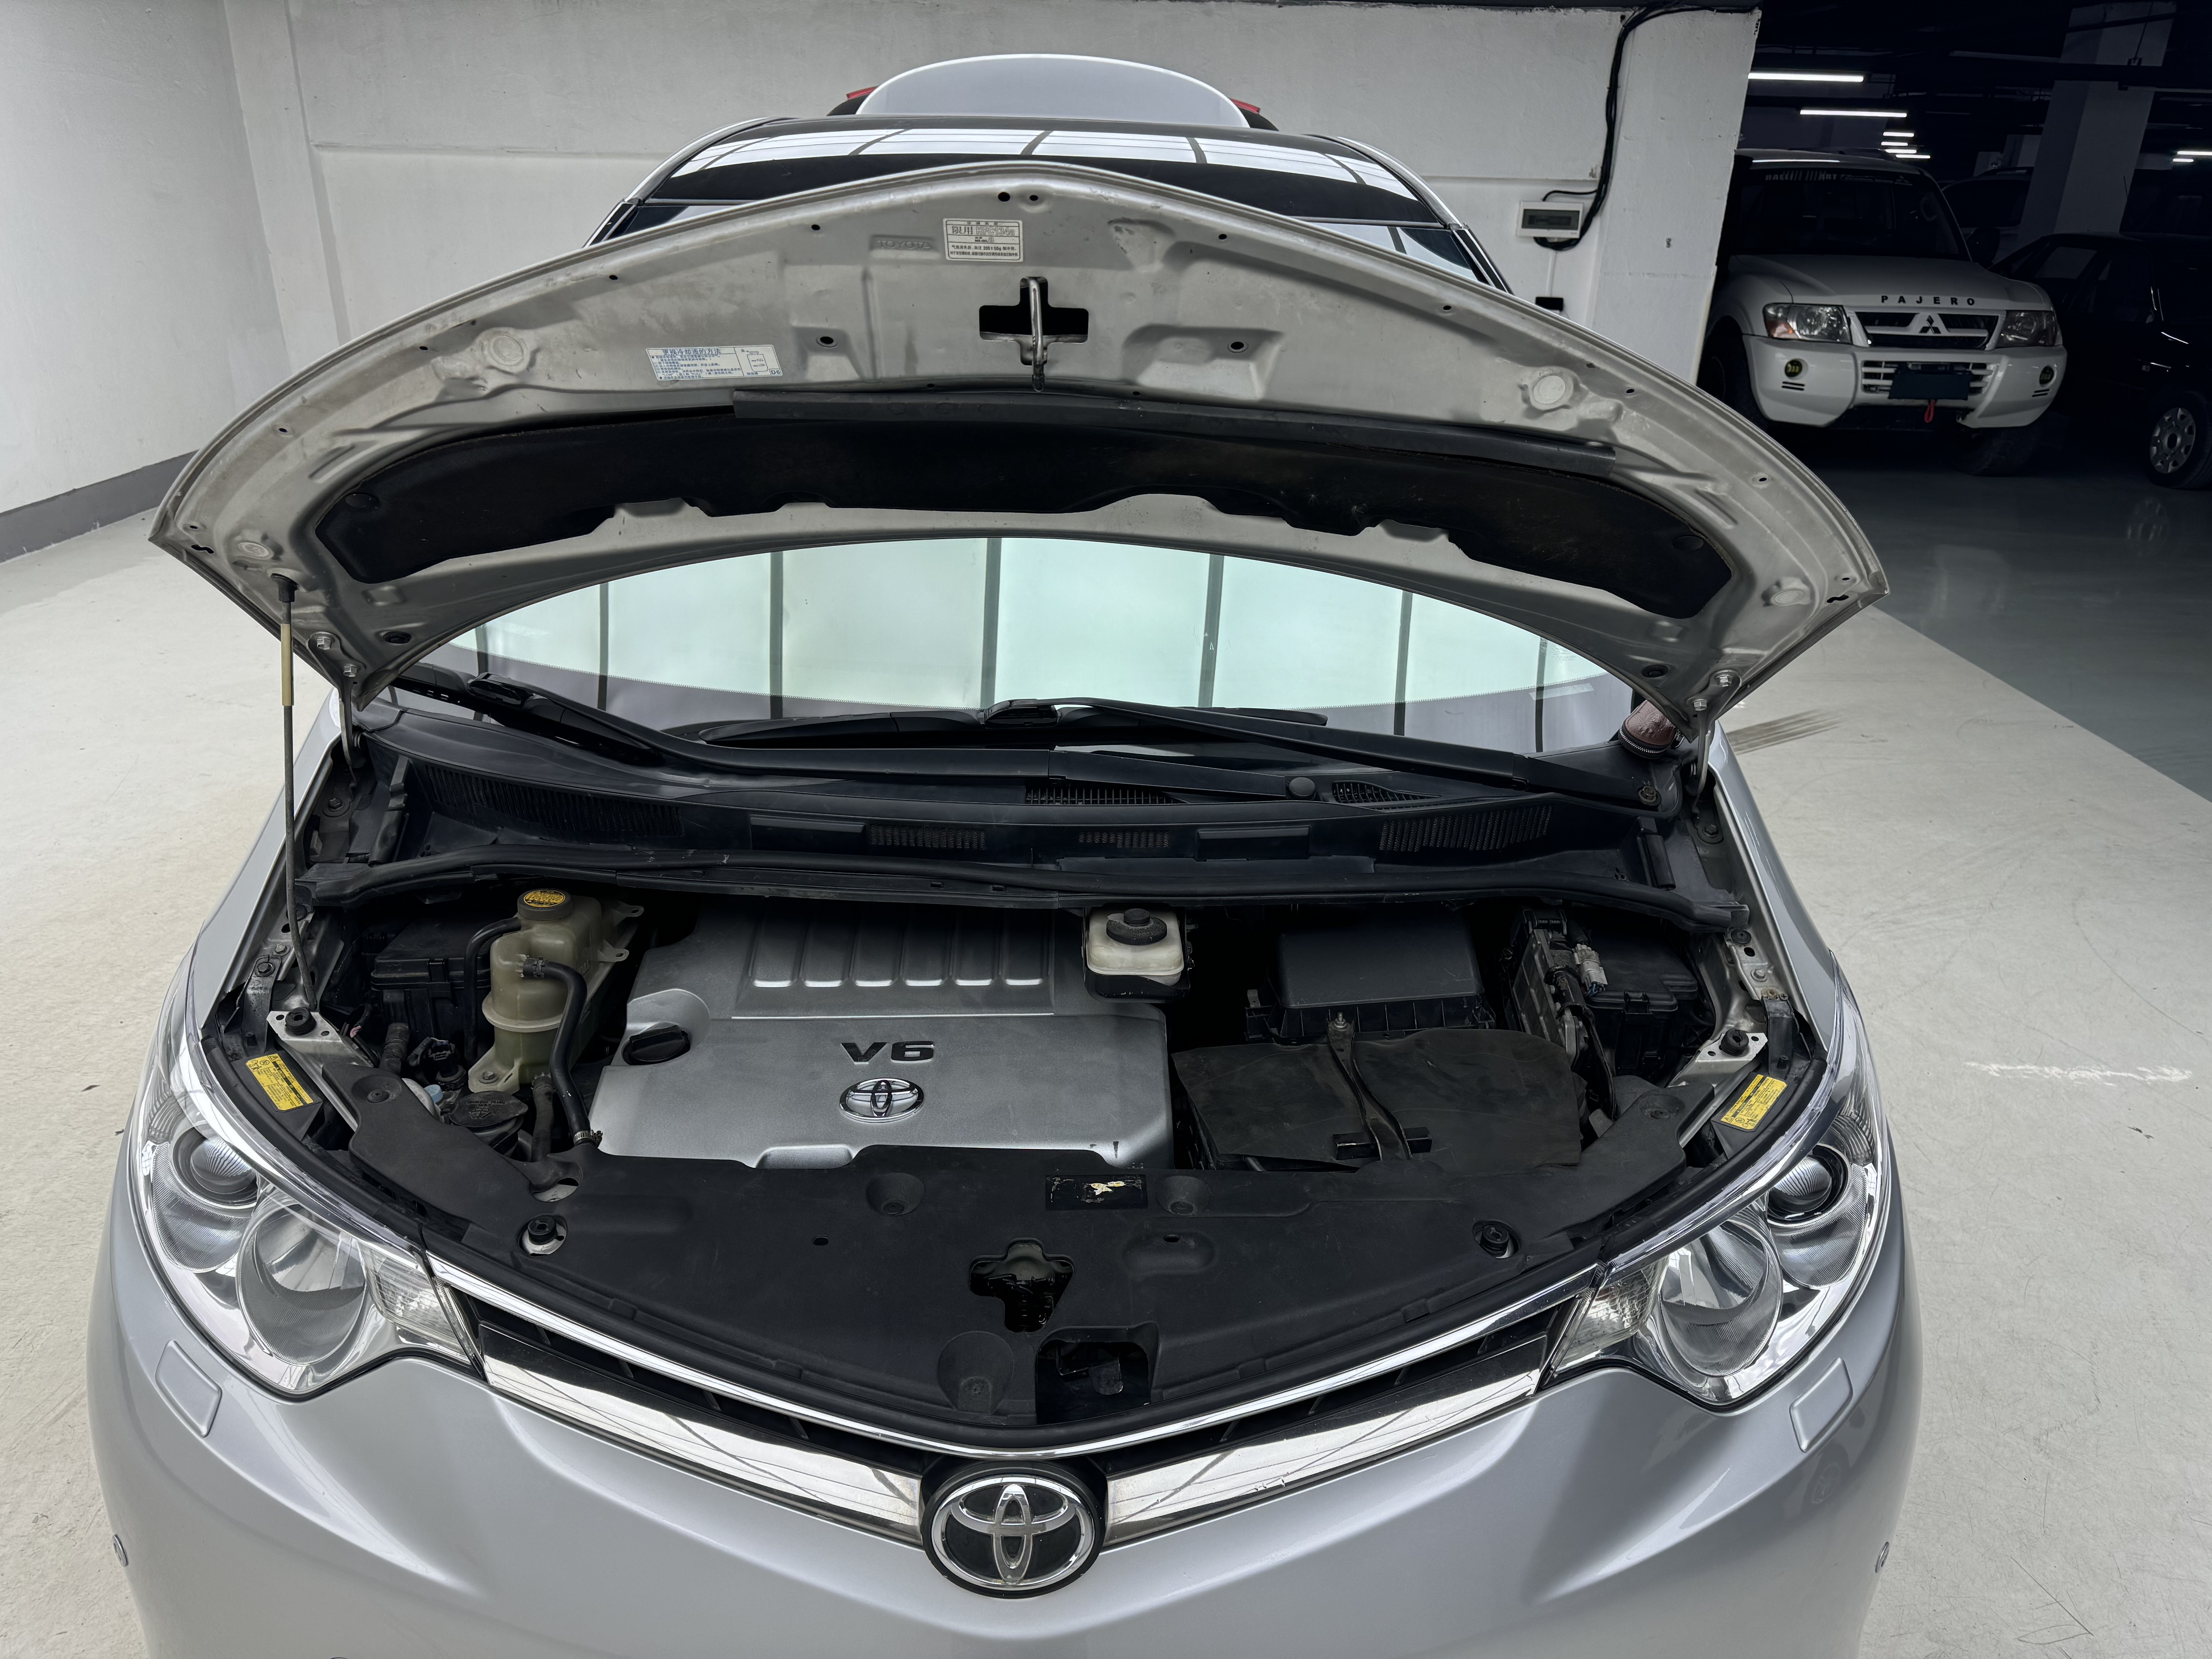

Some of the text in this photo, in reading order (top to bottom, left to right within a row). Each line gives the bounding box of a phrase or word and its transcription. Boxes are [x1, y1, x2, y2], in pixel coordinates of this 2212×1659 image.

[952, 226, 1015, 236] 限用 HFC134a
[877, 241, 932, 250] TOYOTA
[1881, 295, 1975, 306] PAJERO
[840, 1041, 935, 1065] V6
